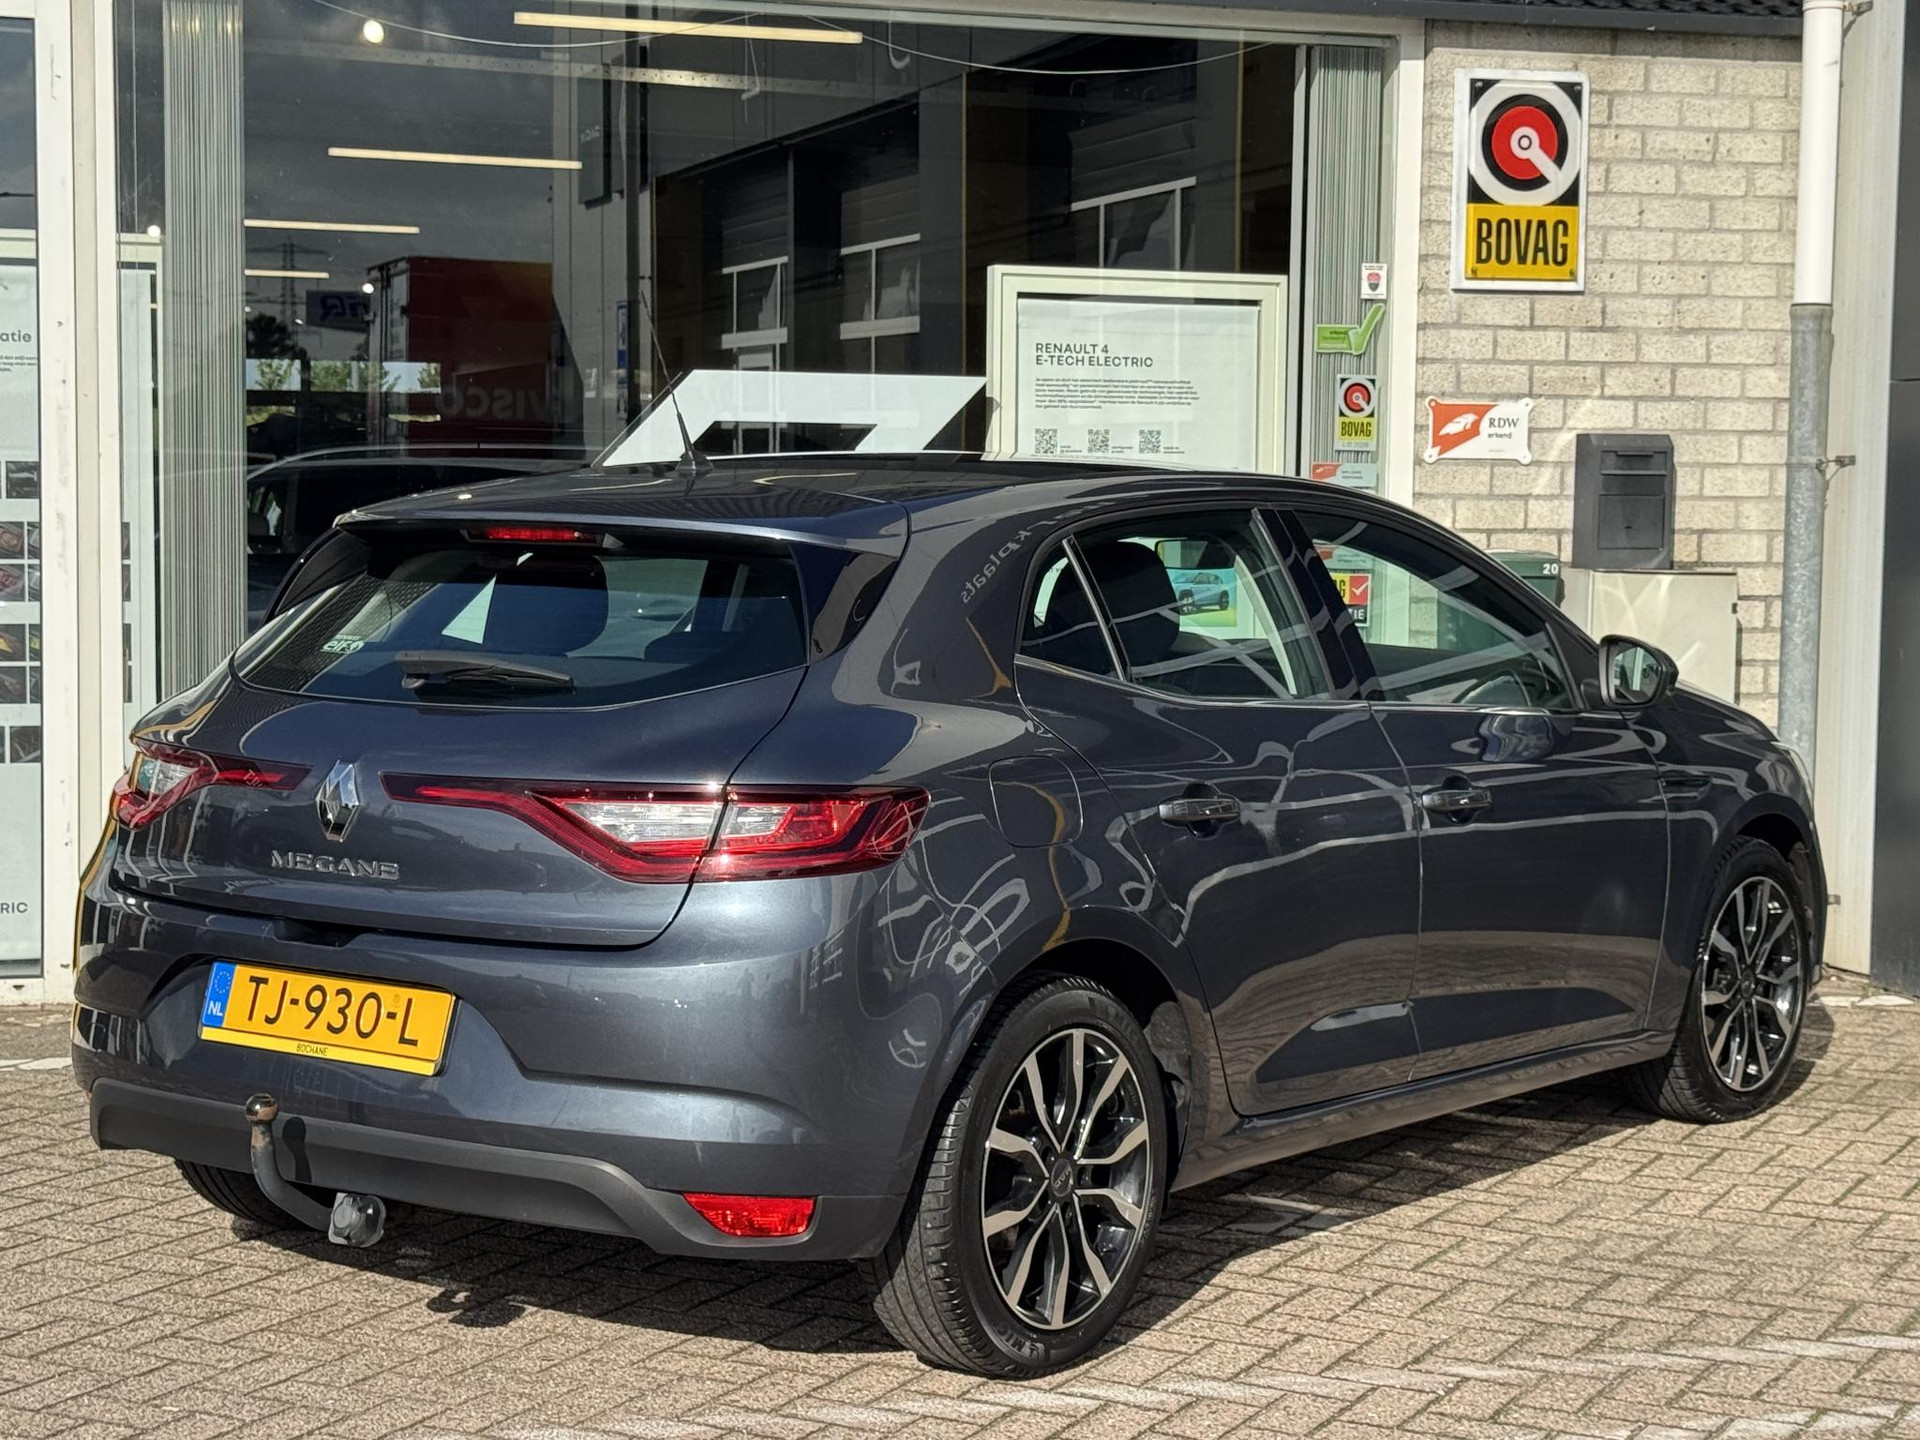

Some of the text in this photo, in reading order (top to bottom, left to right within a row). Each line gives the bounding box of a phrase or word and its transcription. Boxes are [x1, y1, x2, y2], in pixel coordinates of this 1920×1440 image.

[1476, 217, 1569, 267] BOVAG
[1035, 343, 1109, 355] RENAULT 4
[1035, 355, 1154, 368] E-TECH ELECTRIC
[1340, 421, 1372, 438] BOVAG
[1488, 417, 1519, 429] RDW
[1487, 432, 1512, 440] erkend
[1542, 563, 1559, 575] 20
[271, 849, 400, 880] MEGANE
[0, 902, 28, 914] RIC
[207, 1000, 224, 1017] NL
[249, 975, 419, 1048] TJ-930-L
[296, 1043, 328, 1057] BOCHANE
